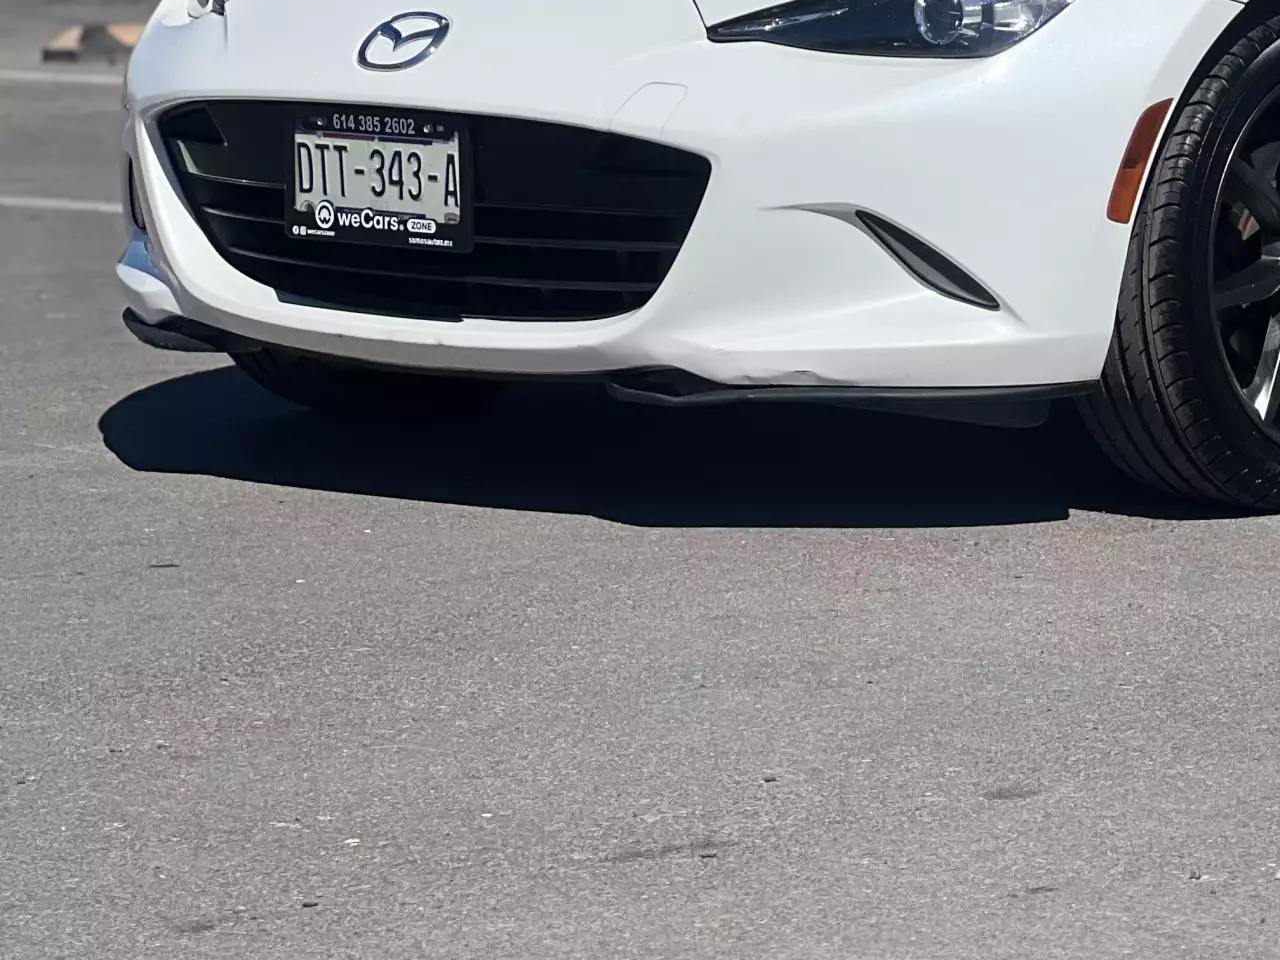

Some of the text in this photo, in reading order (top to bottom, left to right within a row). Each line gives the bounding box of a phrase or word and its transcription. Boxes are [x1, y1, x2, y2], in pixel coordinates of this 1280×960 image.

[333, 113, 415, 135] 614 385 2602
[297, 141, 459, 208] DTT-343-A
[411, 221, 432, 231] ZONE
